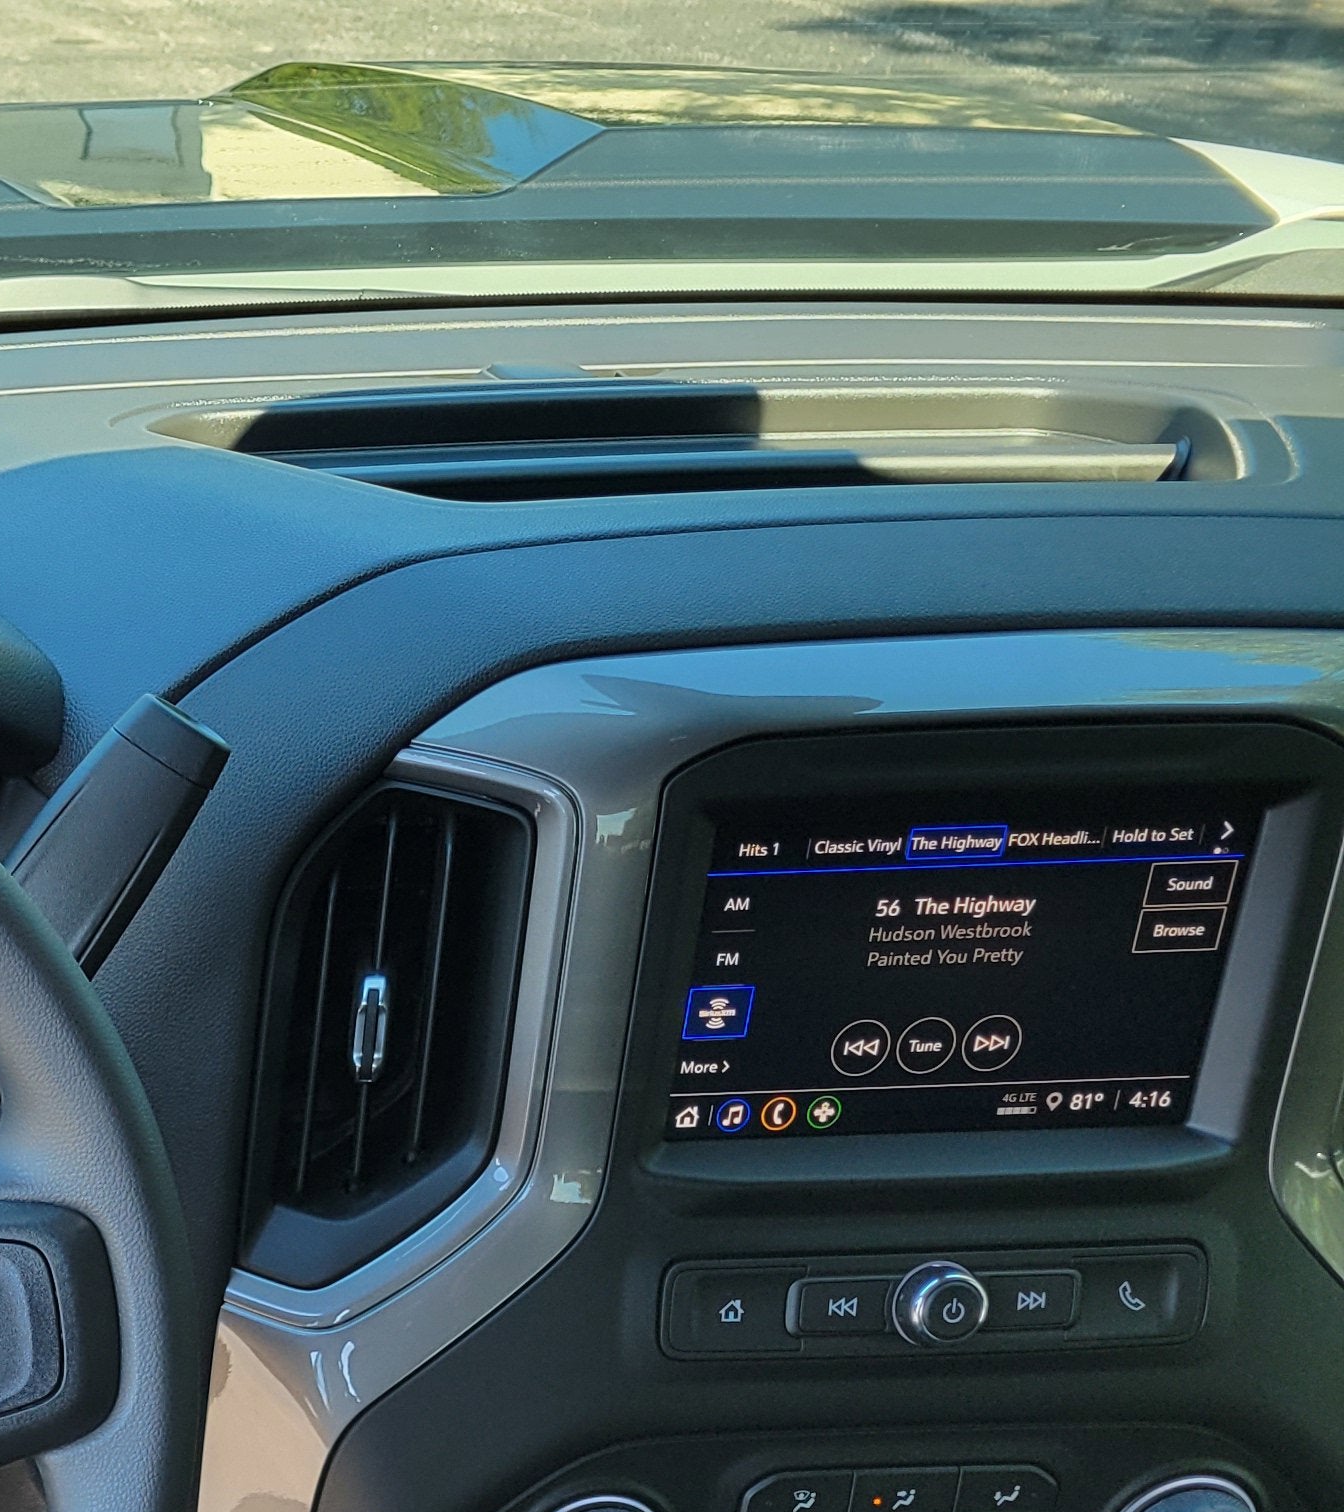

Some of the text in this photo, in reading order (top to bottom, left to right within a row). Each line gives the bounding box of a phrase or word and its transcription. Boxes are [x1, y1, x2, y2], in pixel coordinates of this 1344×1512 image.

[1008, 832, 1040, 847] FOX
[1112, 827, 1194, 843] Hold to Set
[739, 842, 780, 857] Hits 1
[814, 837, 902, 855] Classic Vinyl
[912, 834, 1003, 853] The Highway
[1166, 876, 1214, 892] Sound
[723, 896, 750, 911] AM
[875, 895, 1037, 918] 56 The Highway
[868, 921, 1032, 943] Hudson Westbrook
[1152, 923, 1205, 938] Browse
[716, 952, 740, 966] FM
[867, 947, 1023, 967] Painted You Pretty
[908, 1039, 942, 1053] Tune
[680, 1061, 719, 1074] More
[1002, 1092, 1038, 1103] 4G LTE
[1128, 1091, 1172, 1108] 4:16
